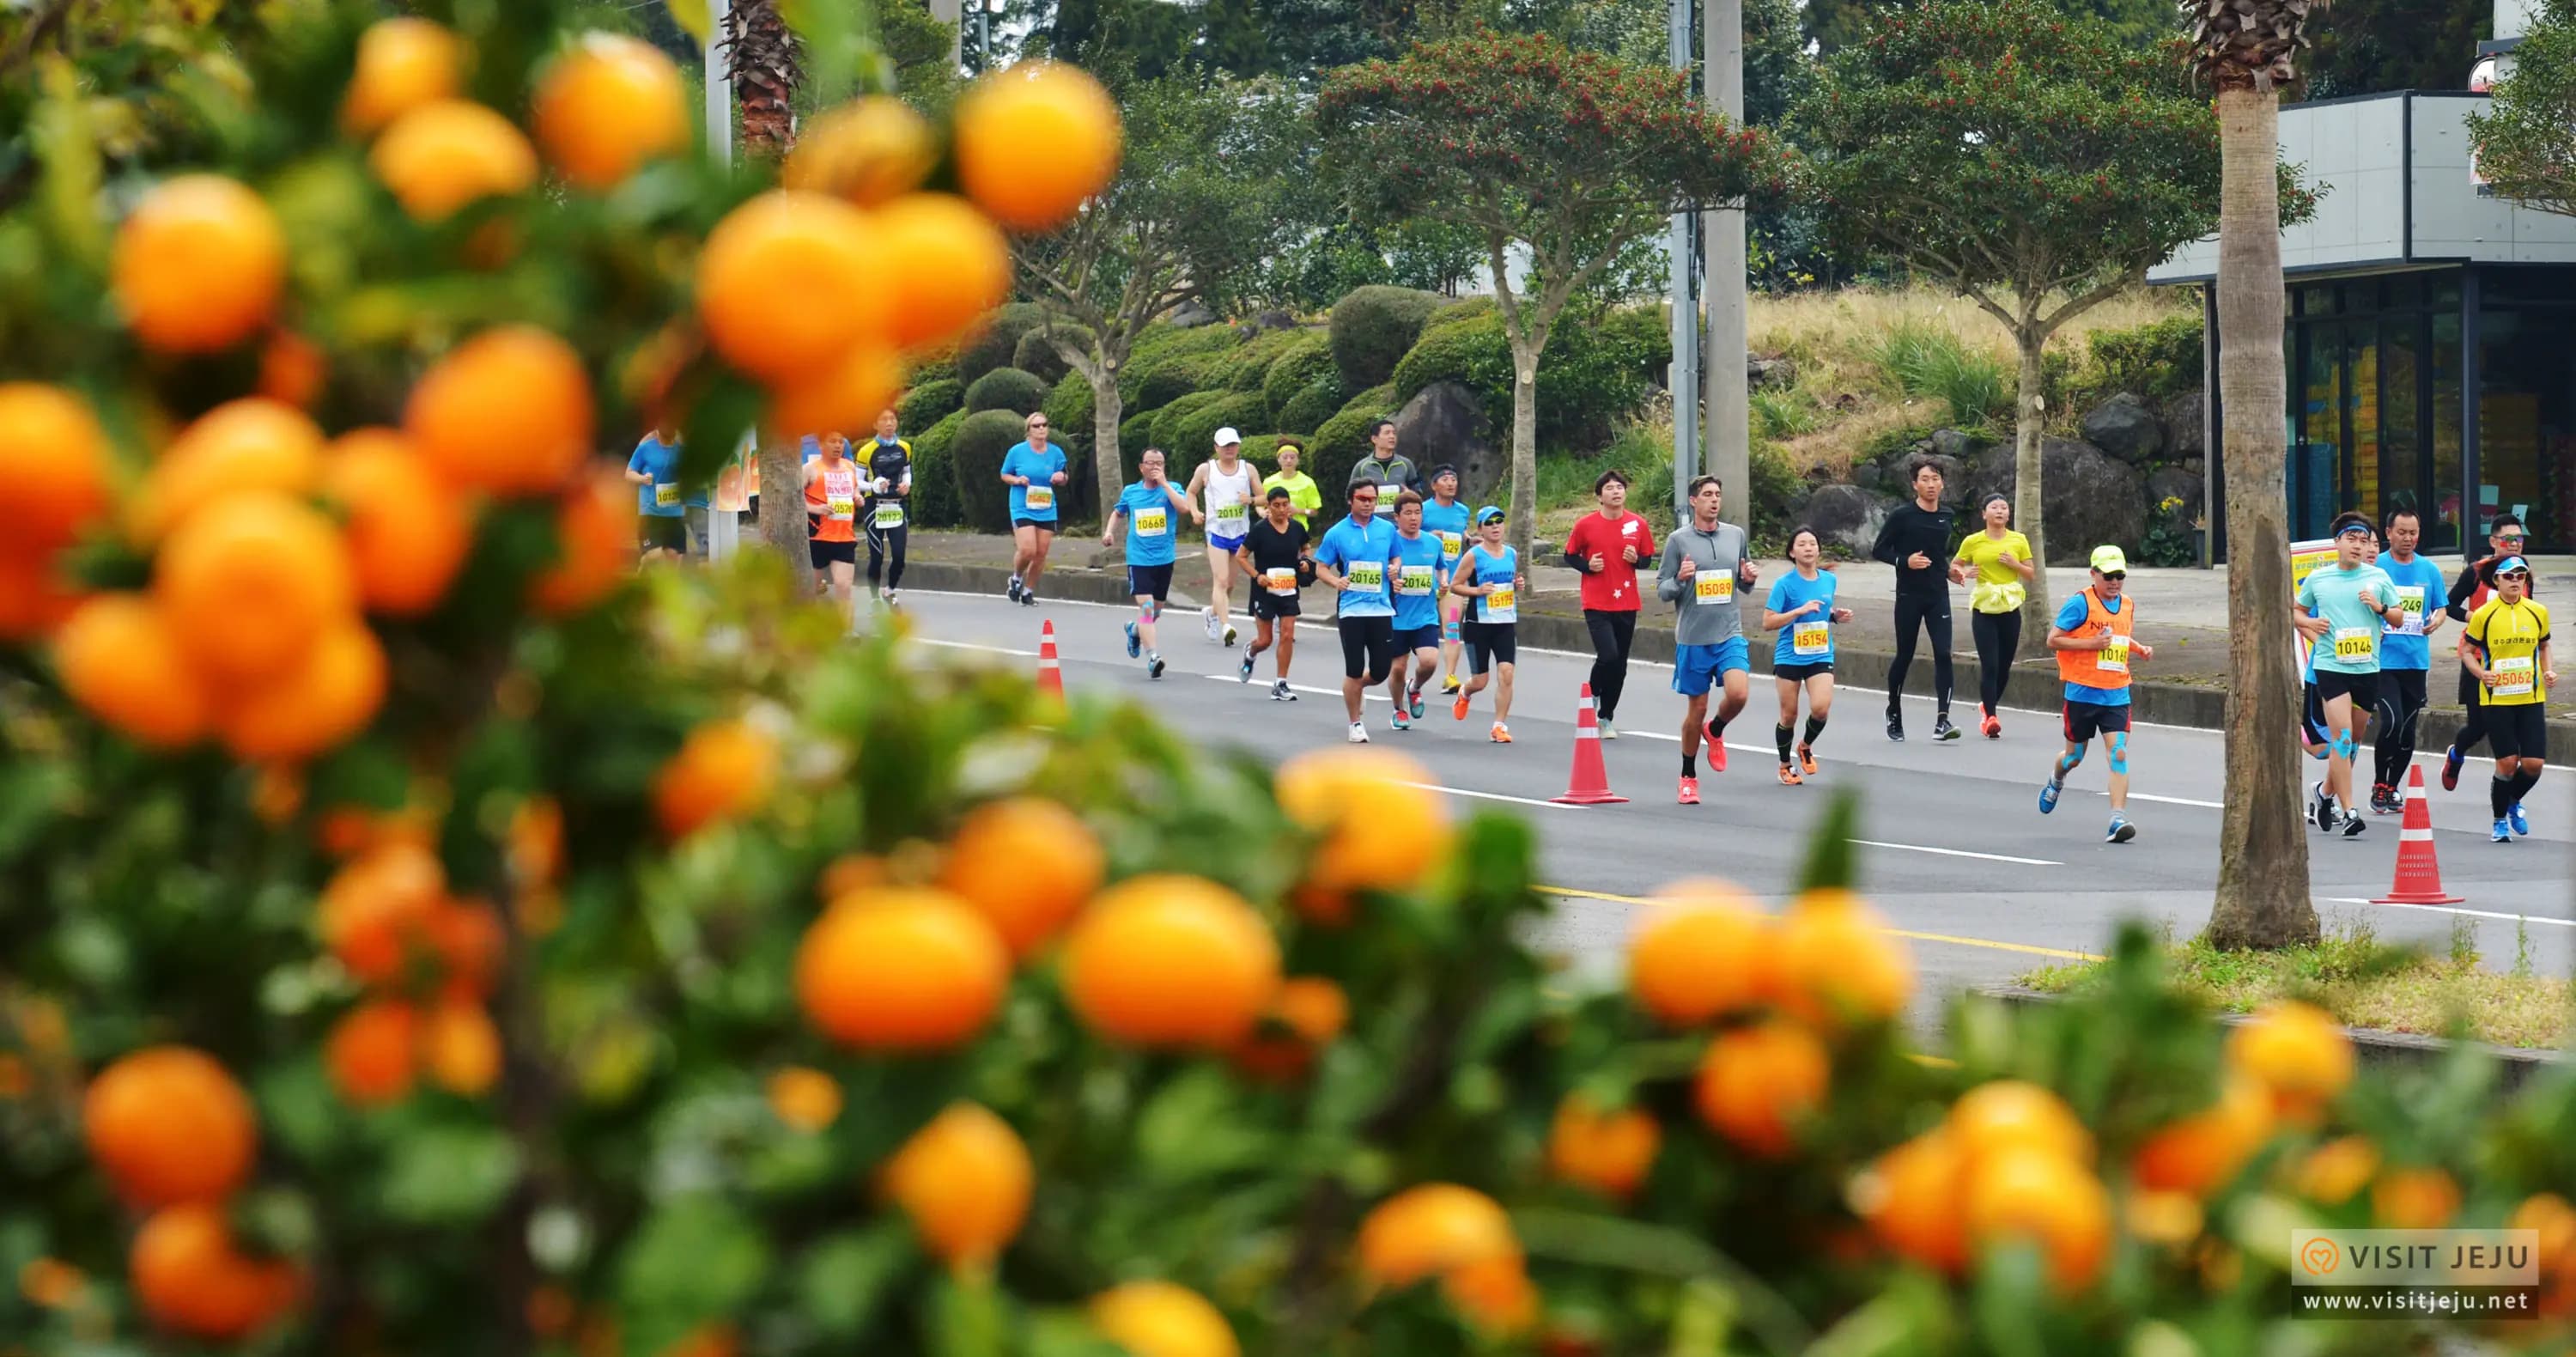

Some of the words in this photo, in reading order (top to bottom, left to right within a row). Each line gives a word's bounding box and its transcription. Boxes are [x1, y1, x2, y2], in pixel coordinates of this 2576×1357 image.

[1138, 517, 1165, 530] 10668
[1350, 572, 1381, 585] 20165
[1403, 577, 1431, 588] 20146
[1698, 582, 1731, 596] 15089
[2400, 599, 2421, 612] 249
[1796, 633, 1827, 647] 15154
[2337, 640, 2372, 654] 10146
[2494, 671, 2532, 686] 25062
